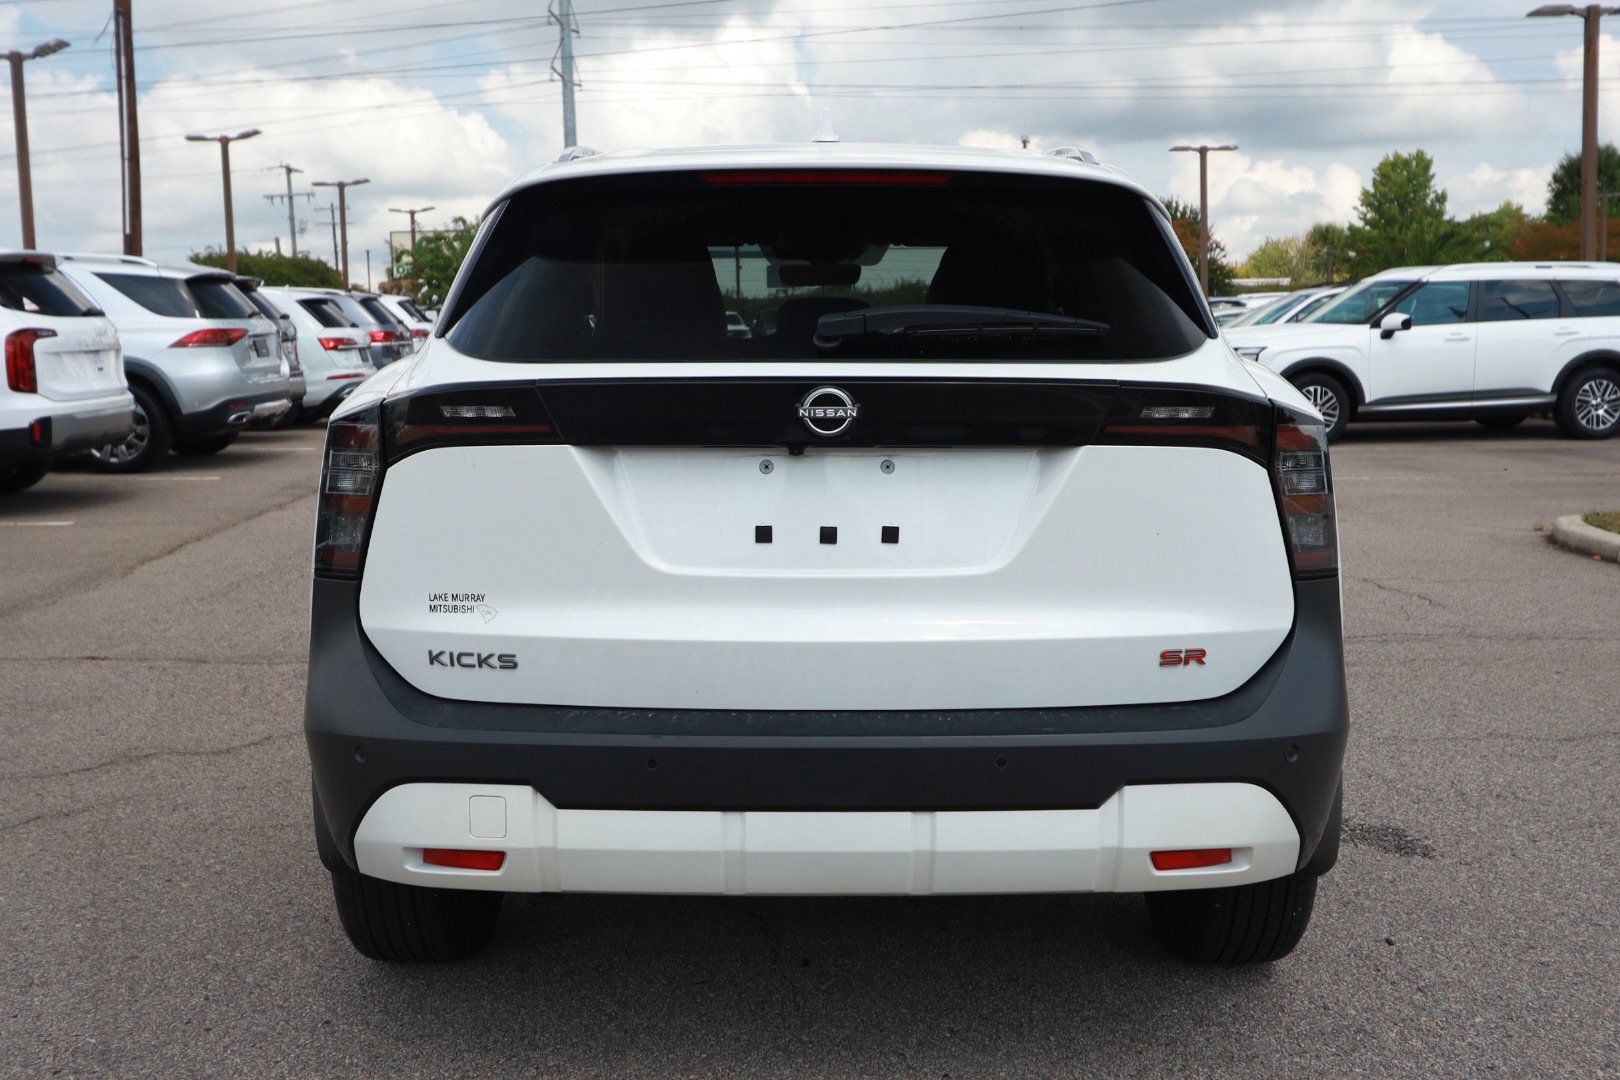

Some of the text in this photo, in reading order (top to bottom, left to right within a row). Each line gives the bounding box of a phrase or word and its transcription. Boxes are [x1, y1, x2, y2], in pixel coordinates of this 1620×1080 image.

[799, 409, 857, 417] NISSAN
[428, 593, 486, 602] LAKE MURRAY
[429, 604, 475, 614] MITSUBISHI
[428, 649, 518, 670] KICKS
[1159, 648, 1207, 667] SR
